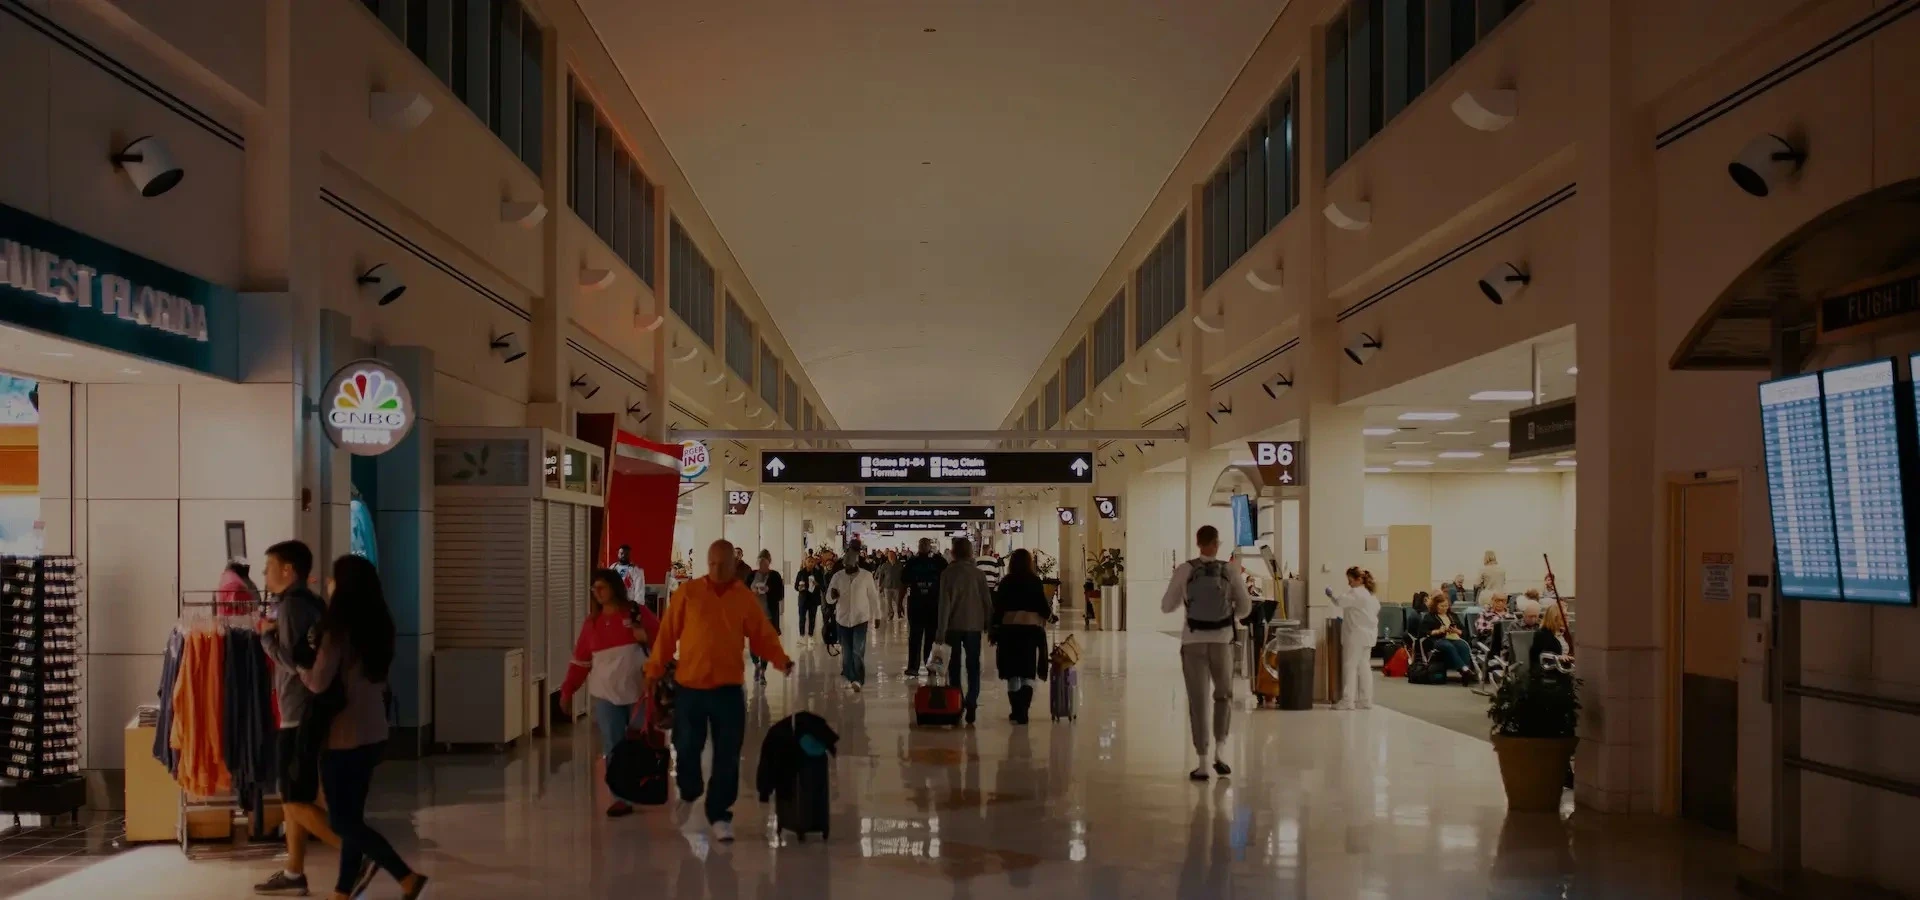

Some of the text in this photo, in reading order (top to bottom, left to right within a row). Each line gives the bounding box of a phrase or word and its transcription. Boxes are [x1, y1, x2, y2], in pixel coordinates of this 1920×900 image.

[101, 273, 208, 342] FLORIDA
[1848, 283, 1900, 320] FLIGHT
[332, 411, 401, 425] CNBC
[684, 446, 704, 456] RGER
[1257, 443, 1294, 466] B6
[684, 453, 705, 467] ING
[872, 457, 898, 467] Gates
[941, 457, 984, 468] Bag Claim
[872, 468, 908, 477] Terminal
[941, 467, 987, 477] Restrooms
[729, 492, 749, 504] B3
